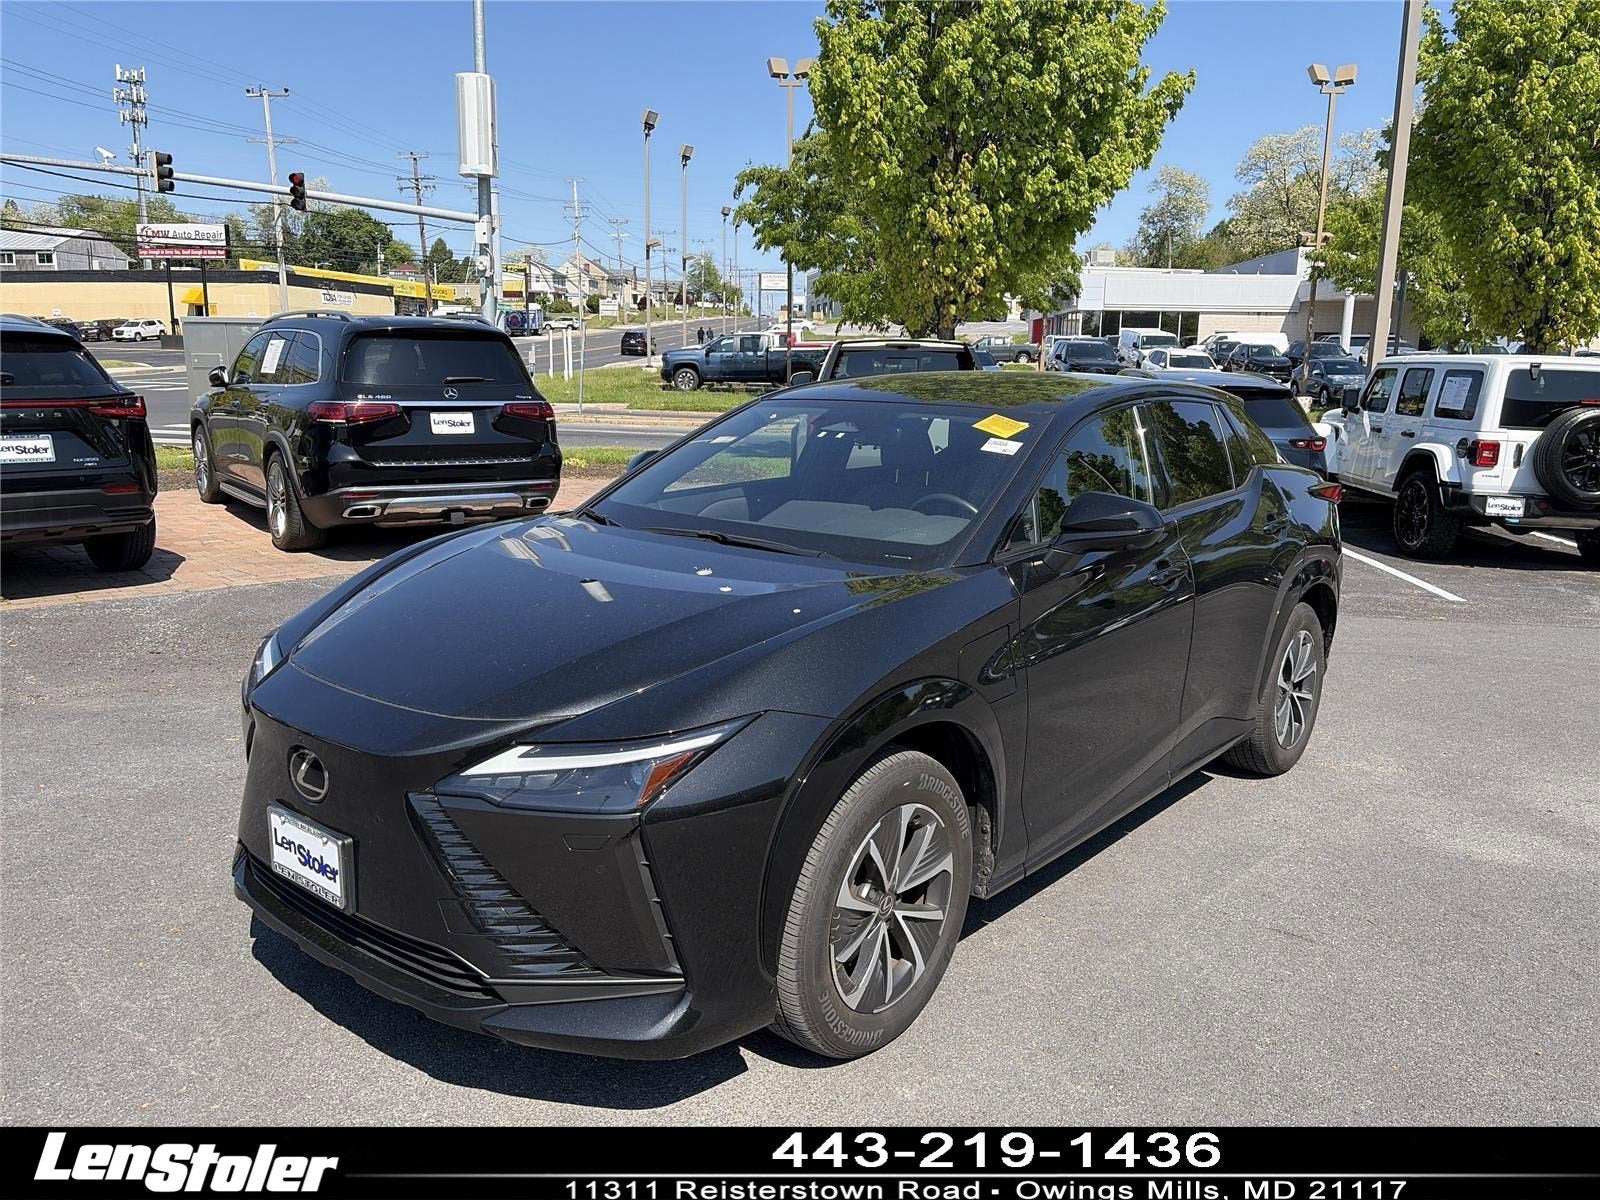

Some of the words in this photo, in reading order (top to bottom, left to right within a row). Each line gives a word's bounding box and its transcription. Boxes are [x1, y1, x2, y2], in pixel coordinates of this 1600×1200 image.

[172, 230, 192, 240] Auto
[194, 230, 223, 241] Repair
[0, 445, 49, 455] enStoler
[918, 773, 970, 840] BRIDGESTONE
[273, 826, 339, 884] LenStoler
[274, 862, 296, 881] LEN
[297, 874, 341, 906] STOLER
[817, 990, 884, 1047] BRIDGESTONE
